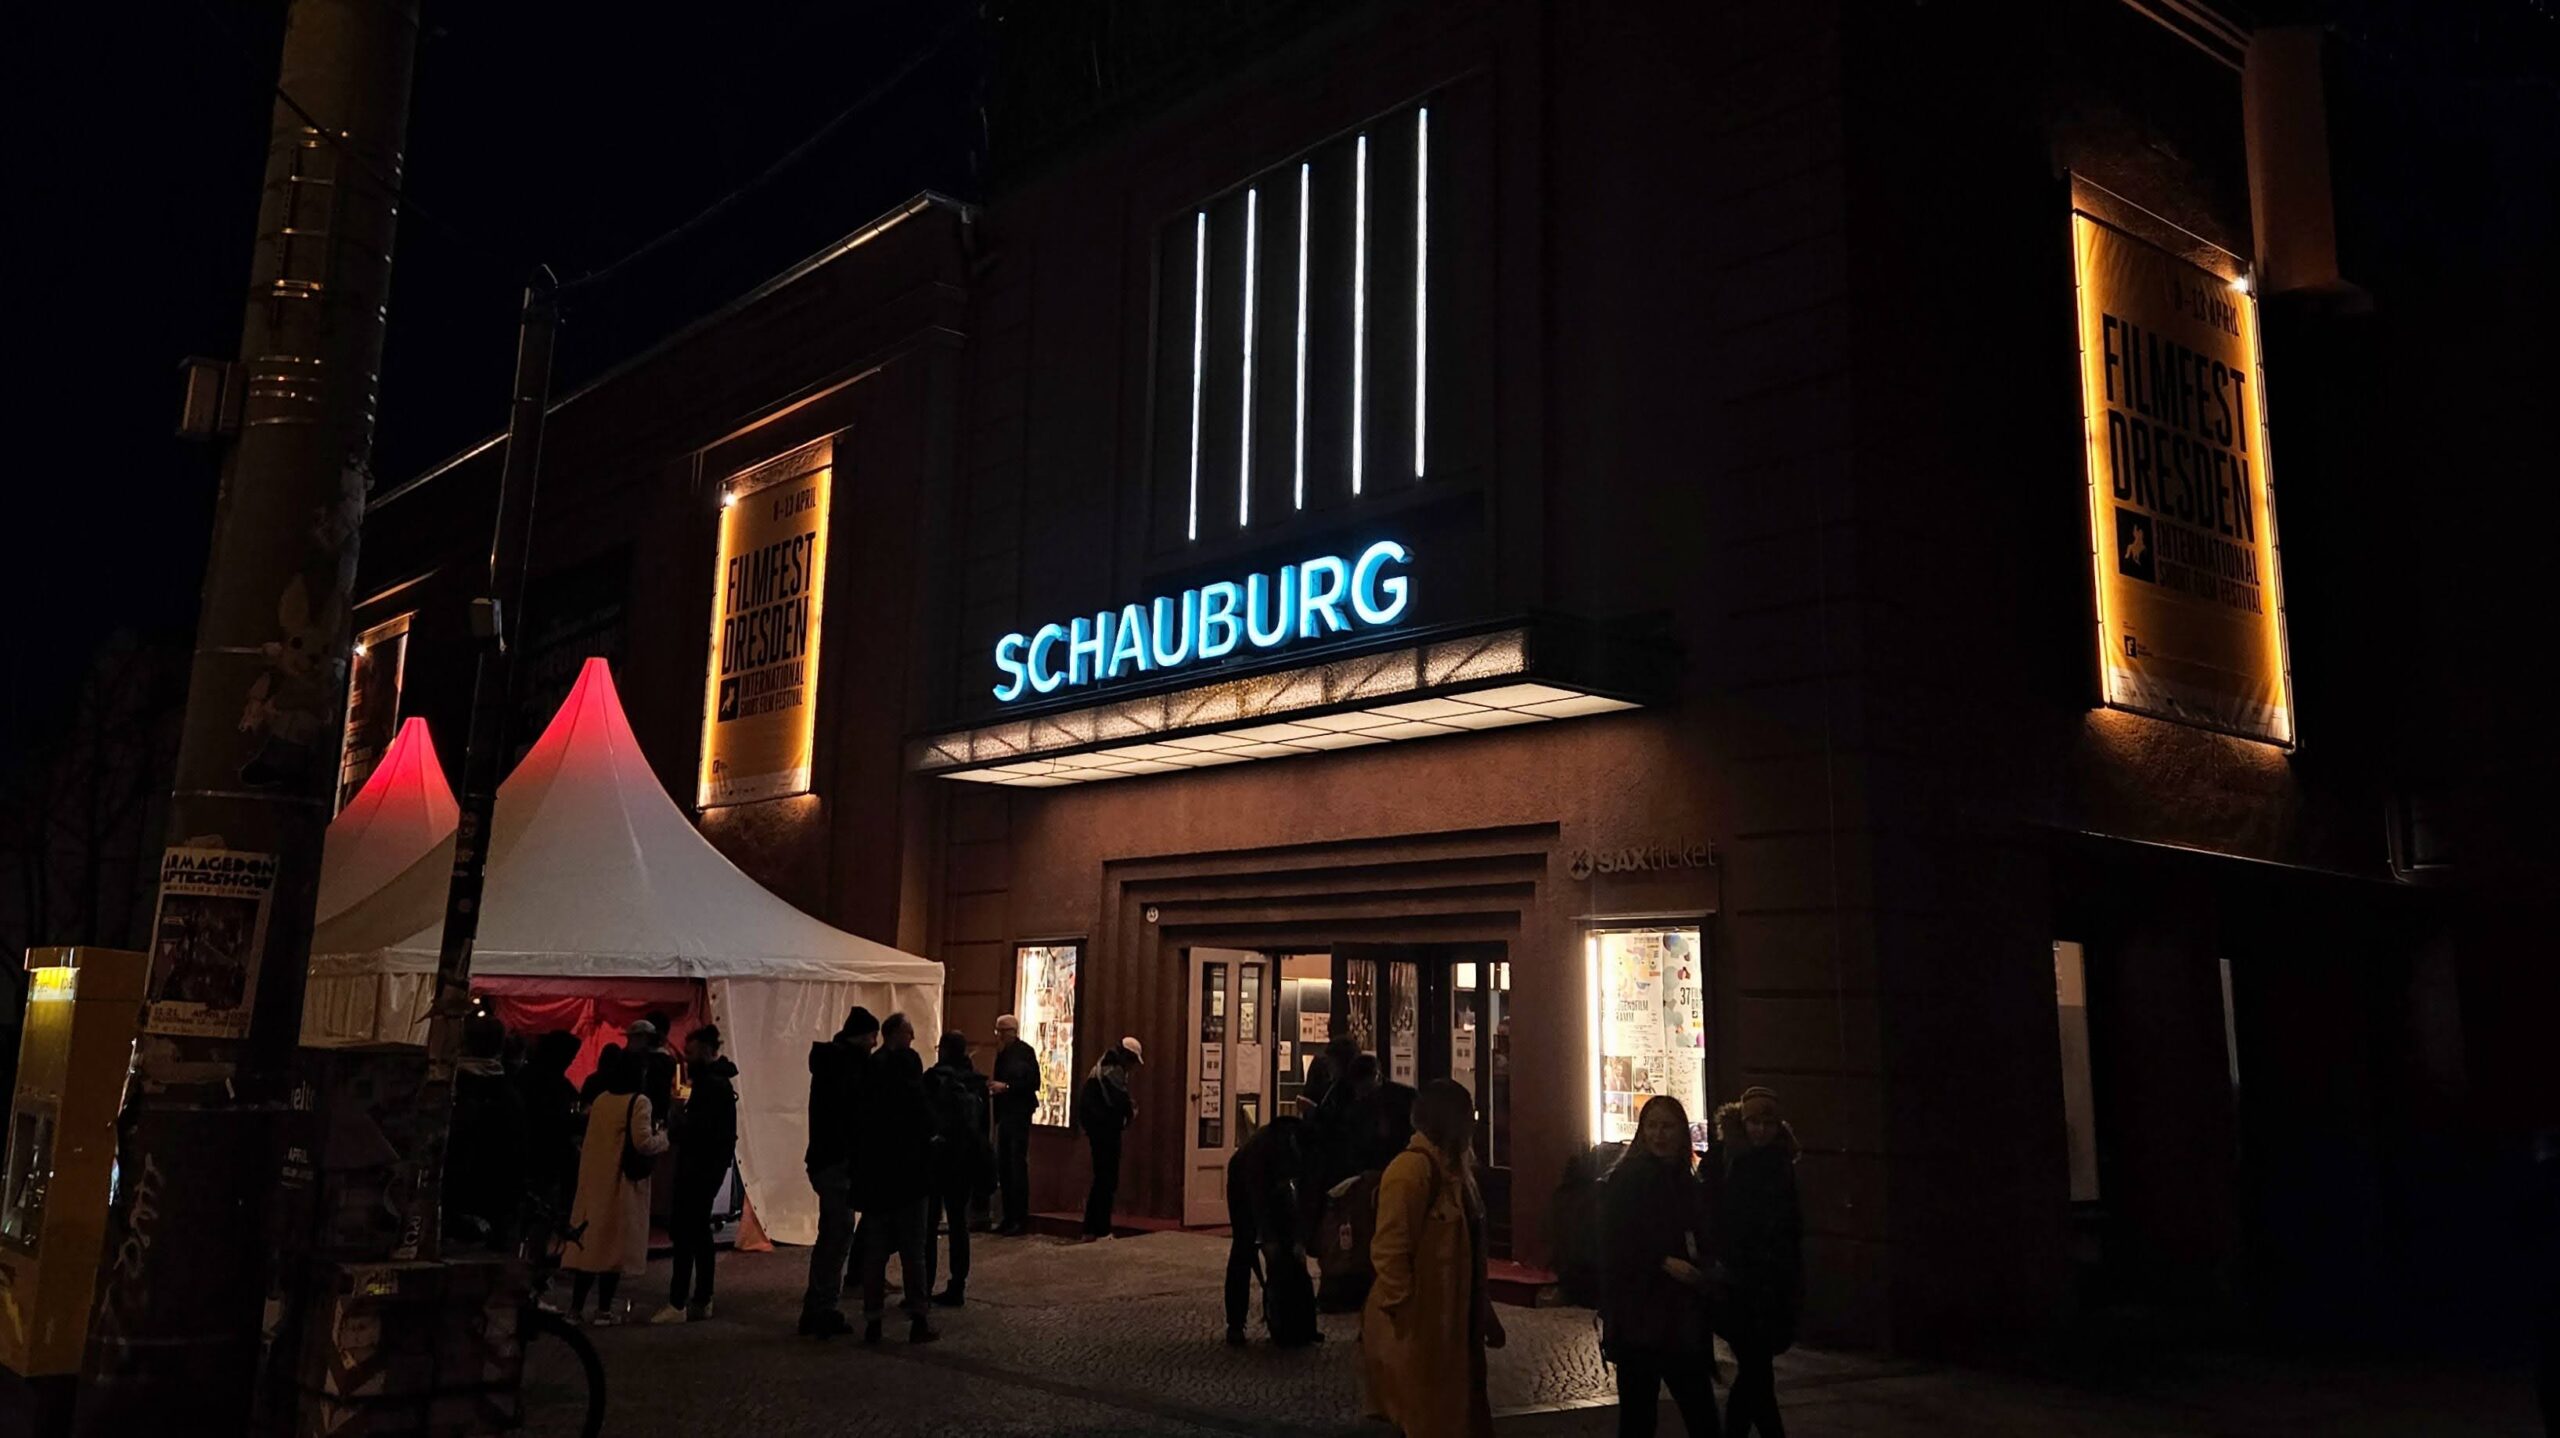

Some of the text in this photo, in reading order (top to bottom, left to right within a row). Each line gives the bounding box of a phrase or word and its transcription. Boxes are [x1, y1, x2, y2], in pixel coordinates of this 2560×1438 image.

[2103, 313, 2247, 453] FILMFEST
[795, 486, 816, 513] APRIL
[2108, 408, 2255, 544] DRESDEN
[726, 531, 816, 614] FILMFEST
[2157, 518, 2261, 586] INTERNATIONAL
[721, 595, 809, 676] DRESDEN
[992, 540, 1416, 702] SCHAUBURG
[741, 660, 804, 699] INTERNATIONAL
[774, 687, 803, 713] FESTIVAL
[1596, 835, 1718, 874] SAXticket
[1680, 987, 1691, 1006] 37
